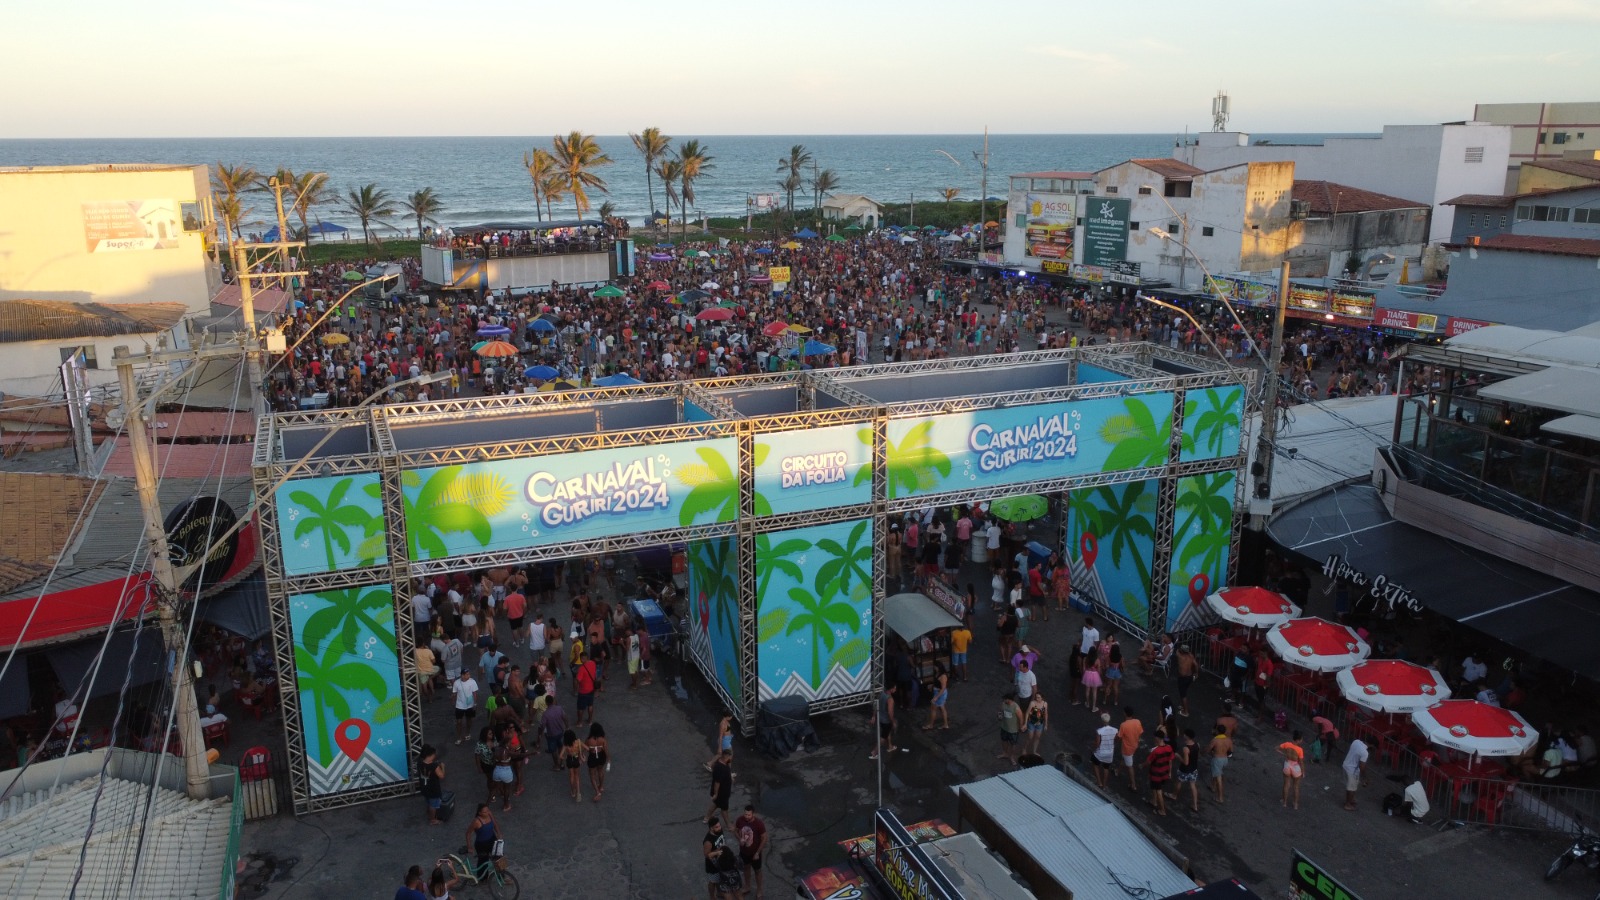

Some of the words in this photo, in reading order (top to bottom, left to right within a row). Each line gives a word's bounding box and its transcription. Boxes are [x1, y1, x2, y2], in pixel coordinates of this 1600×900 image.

[1044, 202, 1055, 211] AG
[1057, 203, 1072, 212] SOL
[1381, 317, 1410, 328] DRINK'S
[1386, 310, 1408, 320] TIANA
[970, 412, 1073, 451] CARNAVAL
[781, 451, 848, 472] CIRCUITO
[980, 445, 1033, 471] GURIRI
[1033, 434, 1077, 461] 2024
[527, 456, 662, 503] CARNAVAL
[782, 472, 803, 488] DA
[806, 467, 846, 486] FOLIA
[542, 496, 612, 526] GURIRI
[612, 482, 670, 512] 2024
[179, 514, 223, 540] Botequm
[1321, 555, 1367, 586] Hora
[1370, 574, 1424, 612] Extra
[1444, 740, 1461, 749] AMSTEL
